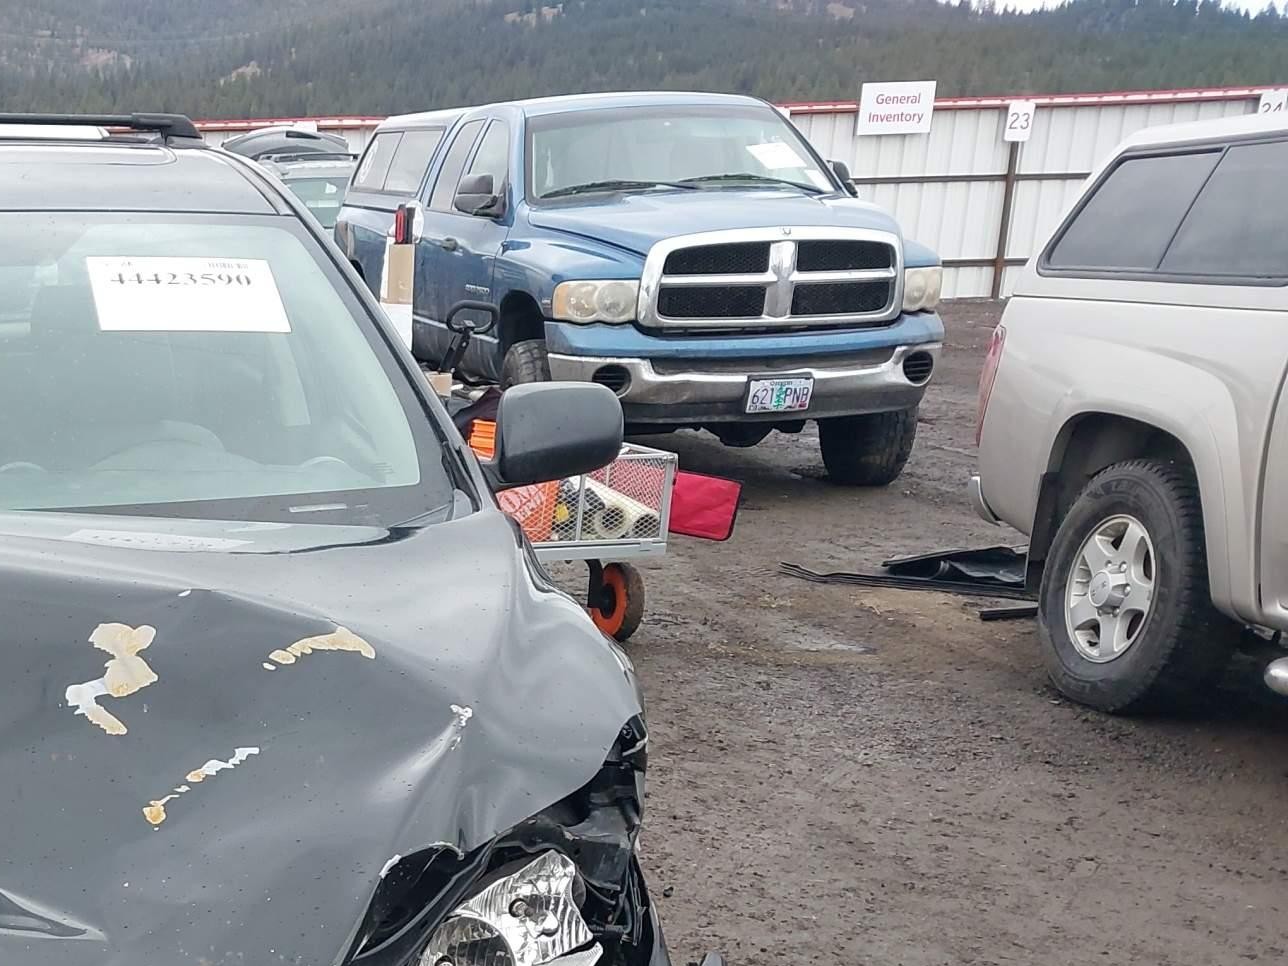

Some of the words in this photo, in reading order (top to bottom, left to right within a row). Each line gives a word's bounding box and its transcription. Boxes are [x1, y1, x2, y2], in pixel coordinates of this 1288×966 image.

[875, 93, 921, 105] General
[868, 111, 924, 123] Inventory
[1008, 112, 1030, 130] 23
[110, 272, 252, 286] 44423590
